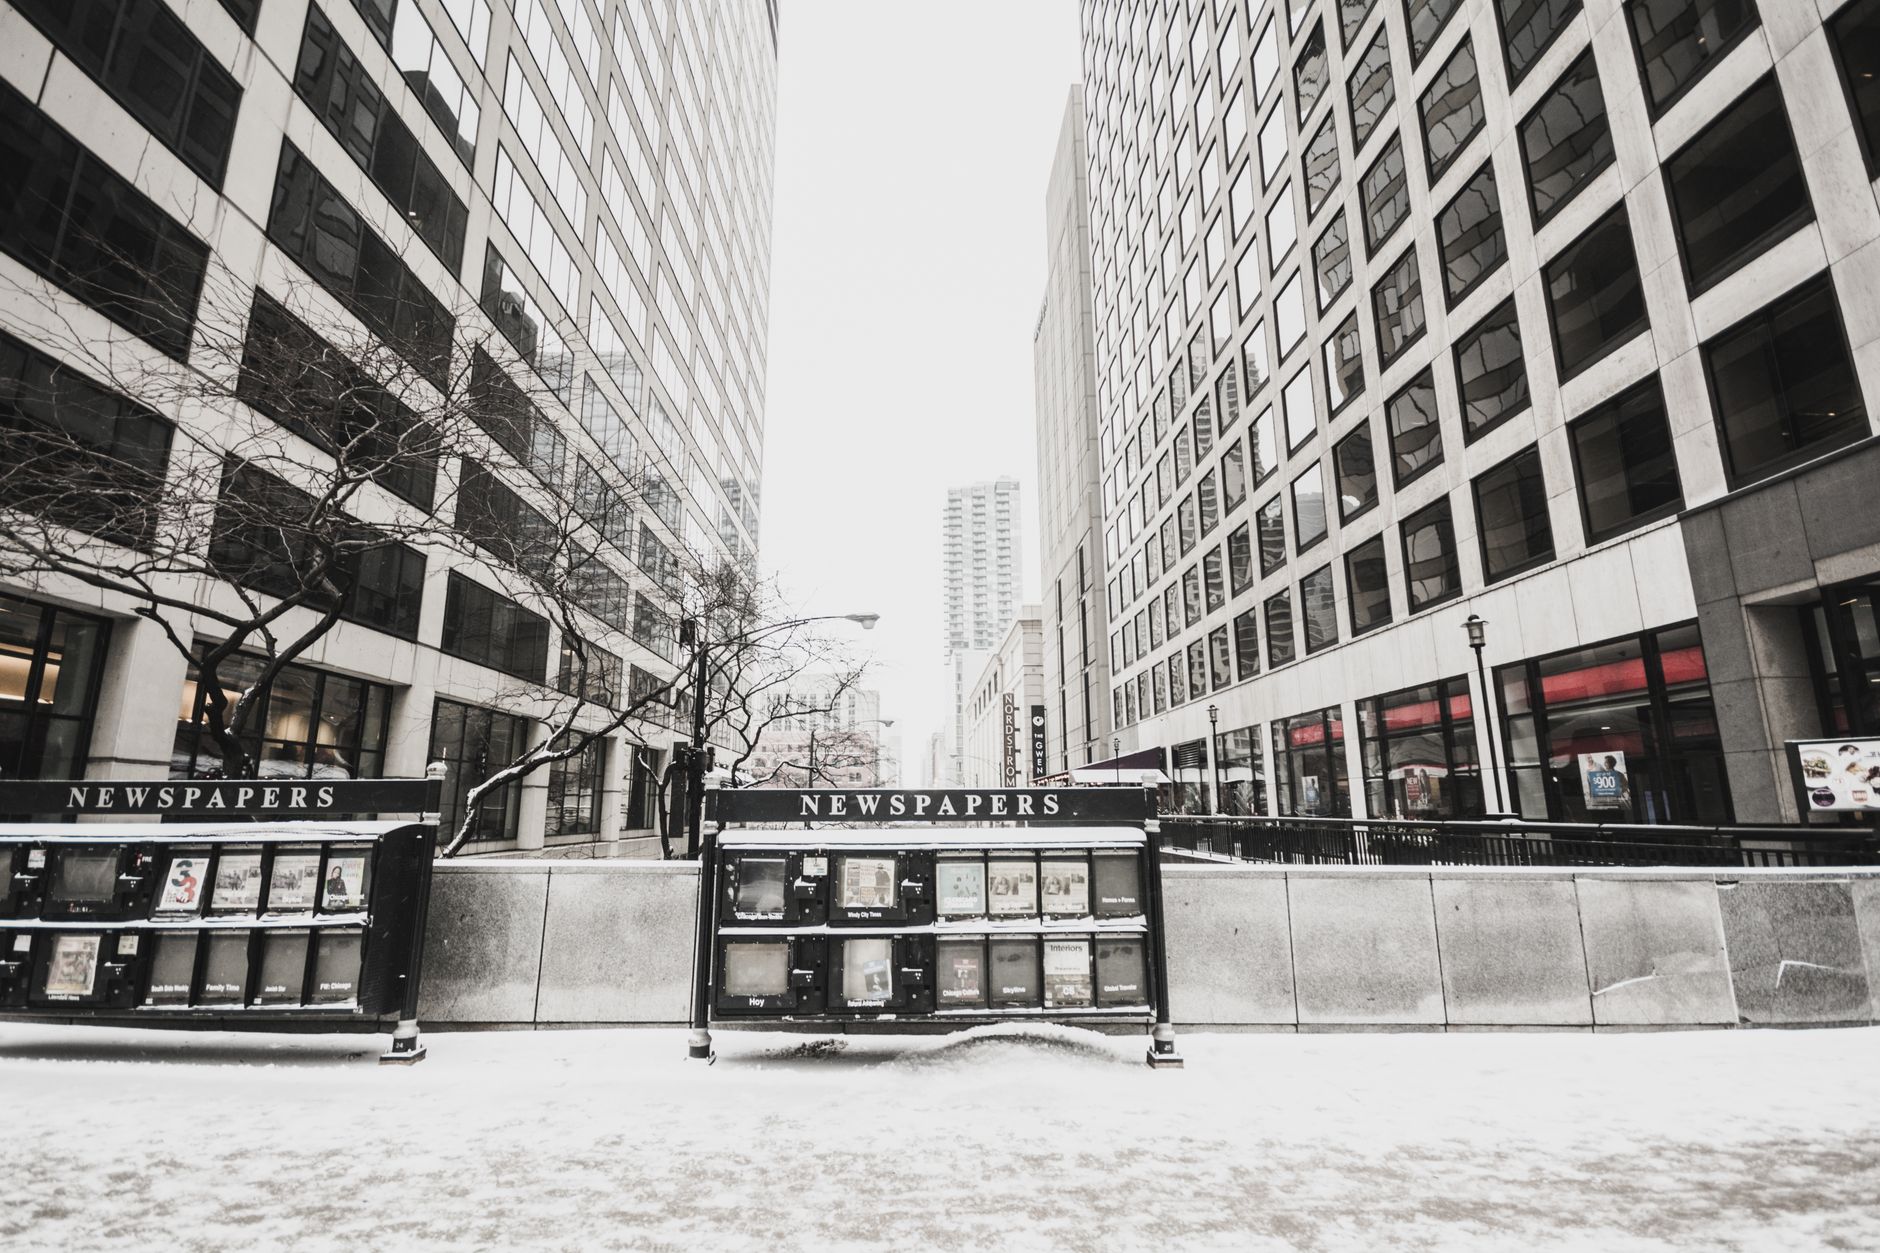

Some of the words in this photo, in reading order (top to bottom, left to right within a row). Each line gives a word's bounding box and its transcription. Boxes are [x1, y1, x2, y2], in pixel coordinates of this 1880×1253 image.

[1004, 694, 1015, 787] NORDSTROM
[1035, 741, 1044, 775] GWEN
[67, 786, 334, 809] NEWSPAPERS
[800, 794, 1060, 816] NEWSPAPERS
[1050, 944, 1083, 952] Interiors
[205, 983, 225, 992] Family
[225, 983, 240, 991] Time
[749, 998, 765, 1007] Hoy
